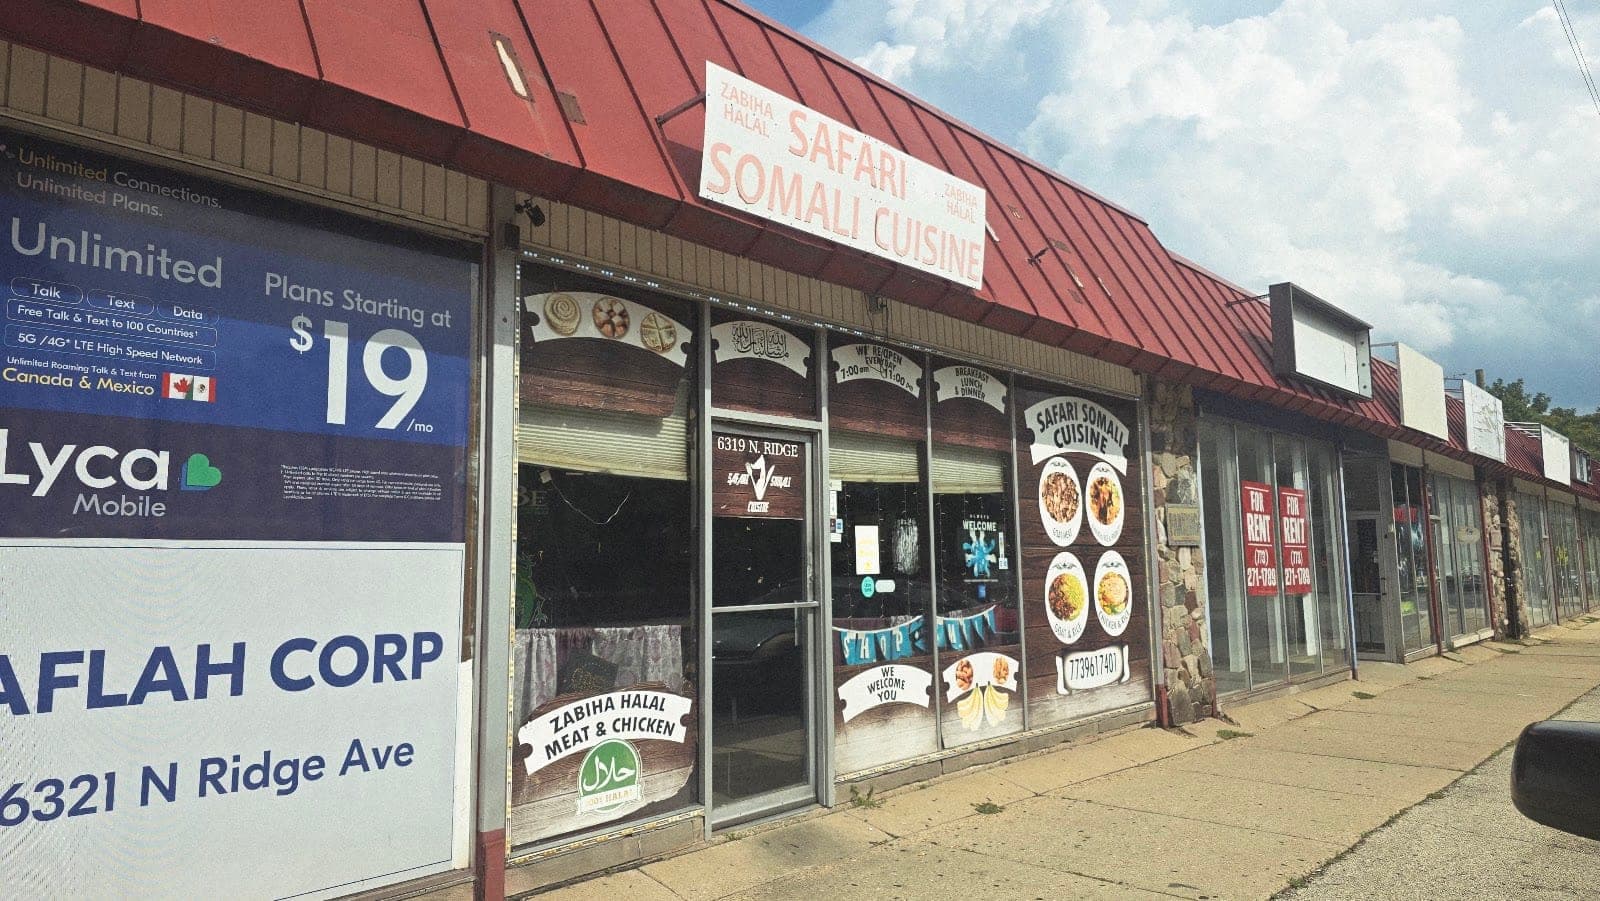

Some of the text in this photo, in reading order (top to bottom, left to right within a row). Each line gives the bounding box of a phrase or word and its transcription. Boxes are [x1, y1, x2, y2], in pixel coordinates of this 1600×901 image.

[720, 81, 774, 120] ZABIHA
[723, 103, 770, 138] HALAL
[788, 108, 906, 201] SAFARI
[19, 148, 222, 209] Unlimited Connections.
[17, 171, 163, 217] Unlimited Plans.
[944, 182, 978, 208] ZABIHA
[706, 141, 982, 282] SOMALI CUISINE
[946, 201, 976, 225] HALAL
[11, 217, 222, 288] Unlimited
[31, 283, 61, 299] Talk
[107, 295, 135, 310] Text
[265, 272, 452, 328] Plans Starting at
[18, 305, 43, 317] Free
[48, 309, 70, 321] Talk
[74, 313, 82, 323] &
[86, 315, 108, 327] Text
[112, 318, 123, 328] to
[126, 320, 144, 331] 100
[173, 305, 203, 320] Data
[18, 333, 36, 344] 5G
[74, 340, 94, 351] LTE
[97, 343, 123, 356] High
[126, 347, 158, 361] Speed
[161, 351, 203, 365] Network
[884, 348, 903, 365] OPEN
[7, 356, 157, 380] Unlimited Roaming Talk & Text from
[955, 367, 989, 384] BREAKFAST
[2, 367, 155, 396] Canada & Mexico
[960, 377, 983, 391] LUNCH
[960, 387, 986, 401] DINNER
[406, 418, 434, 433] /mo
[1037, 401, 1123, 448] SAFARI SOMALI
[717, 436, 799, 457] 6319 N. RIDGE
[1054, 424, 1108, 454] CUISINE
[0, 428, 170, 497] Lyca
[72, 493, 166, 517] Mobile
[1250, 490, 1264, 513] FOR
[1286, 496, 1300, 516] FOR
[962, 520, 997, 532] WELCOME
[1247, 513, 1271, 543] RENT
[1284, 516, 1305, 544] RENT
[1254, 549, 1269, 566] (773)
[1247, 568, 1276, 587] 271-1789
[1285, 568, 1310, 586] 271-1789
[269, 631, 444, 693] CORP
[881, 667, 895, 678] WE
[1069, 653, 1117, 681] 7739617401
[867, 677, 906, 695] WELCOME
[878, 690, 897, 702] YOU
[549, 693, 666, 734] ZABIHA HALAL
[544, 717, 675, 760] MEAT & CHICKEN
[0, 738, 415, 827] 6321 N Ridge Ave
[582, 755, 636, 792] حلال
